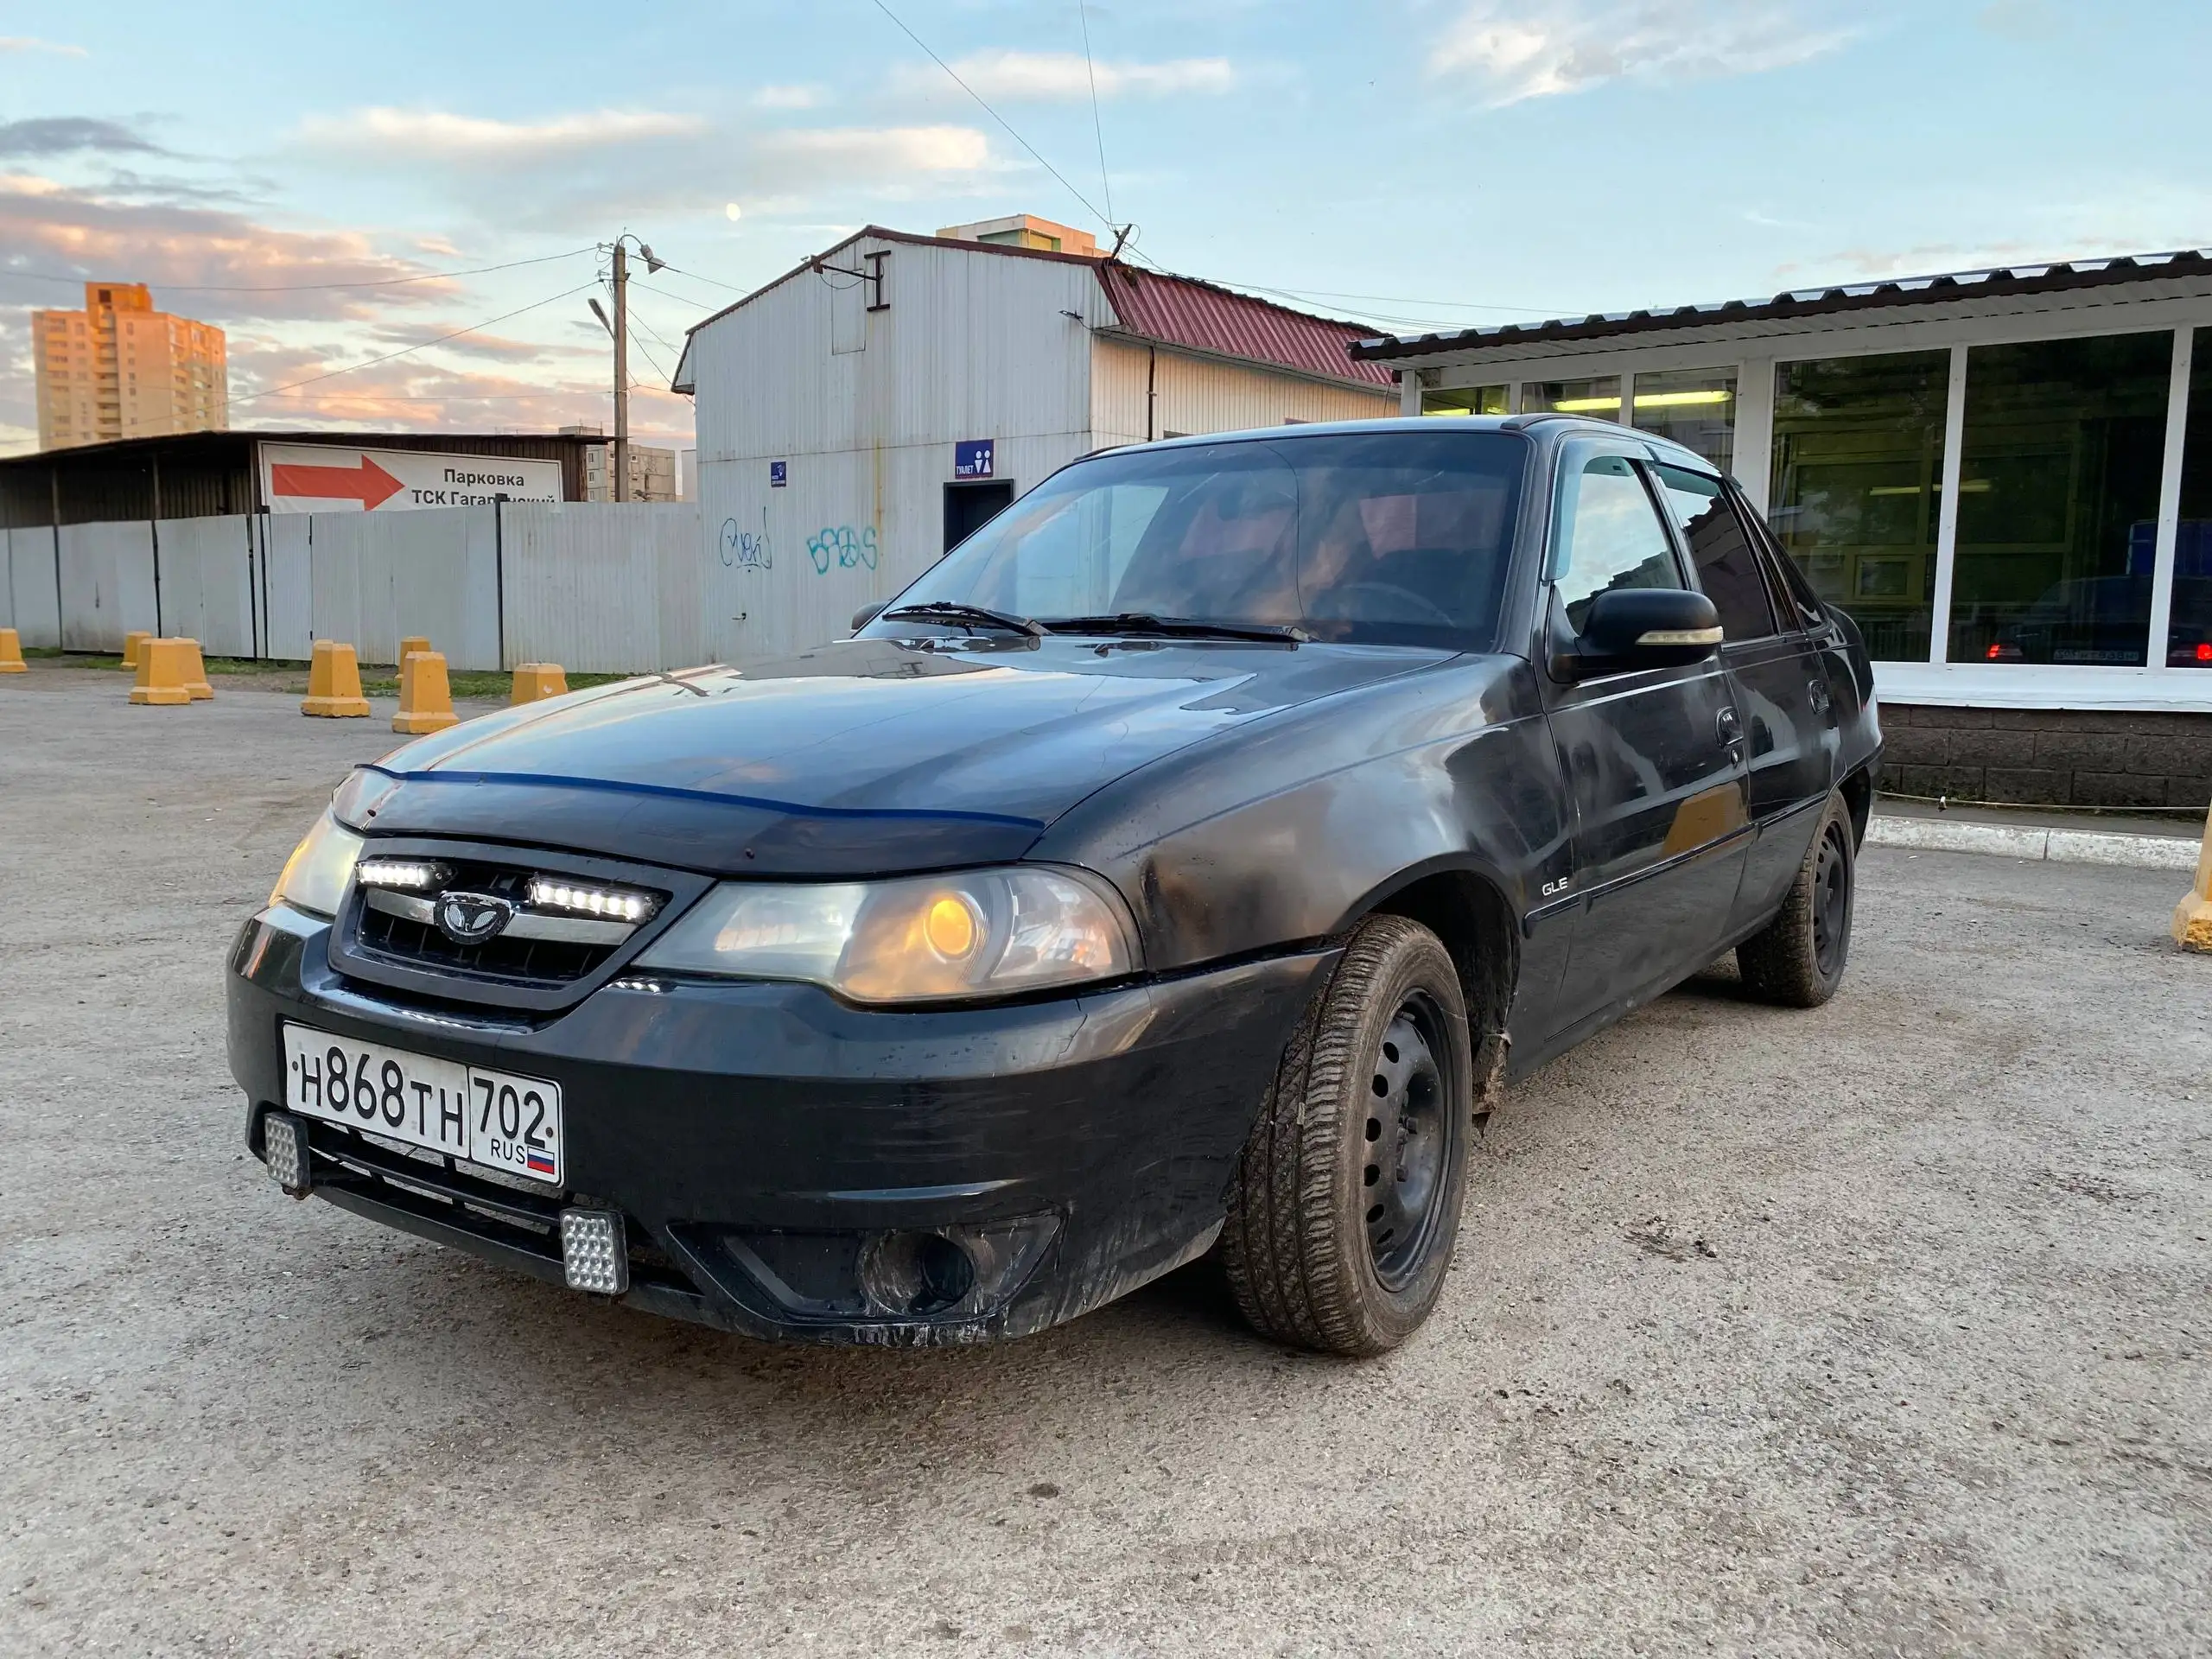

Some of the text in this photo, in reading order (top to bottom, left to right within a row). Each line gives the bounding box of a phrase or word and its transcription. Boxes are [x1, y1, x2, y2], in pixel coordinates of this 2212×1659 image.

[445, 469, 524, 486] Парковка
[956, 465, 974, 474] ТУАЛЕТ
[412, 490, 446, 505] ТСК
[1542, 876, 1568, 896] GLE
[300, 1046, 546, 1149] Н868ТН 702
[491, 1138, 525, 1164] RUS
